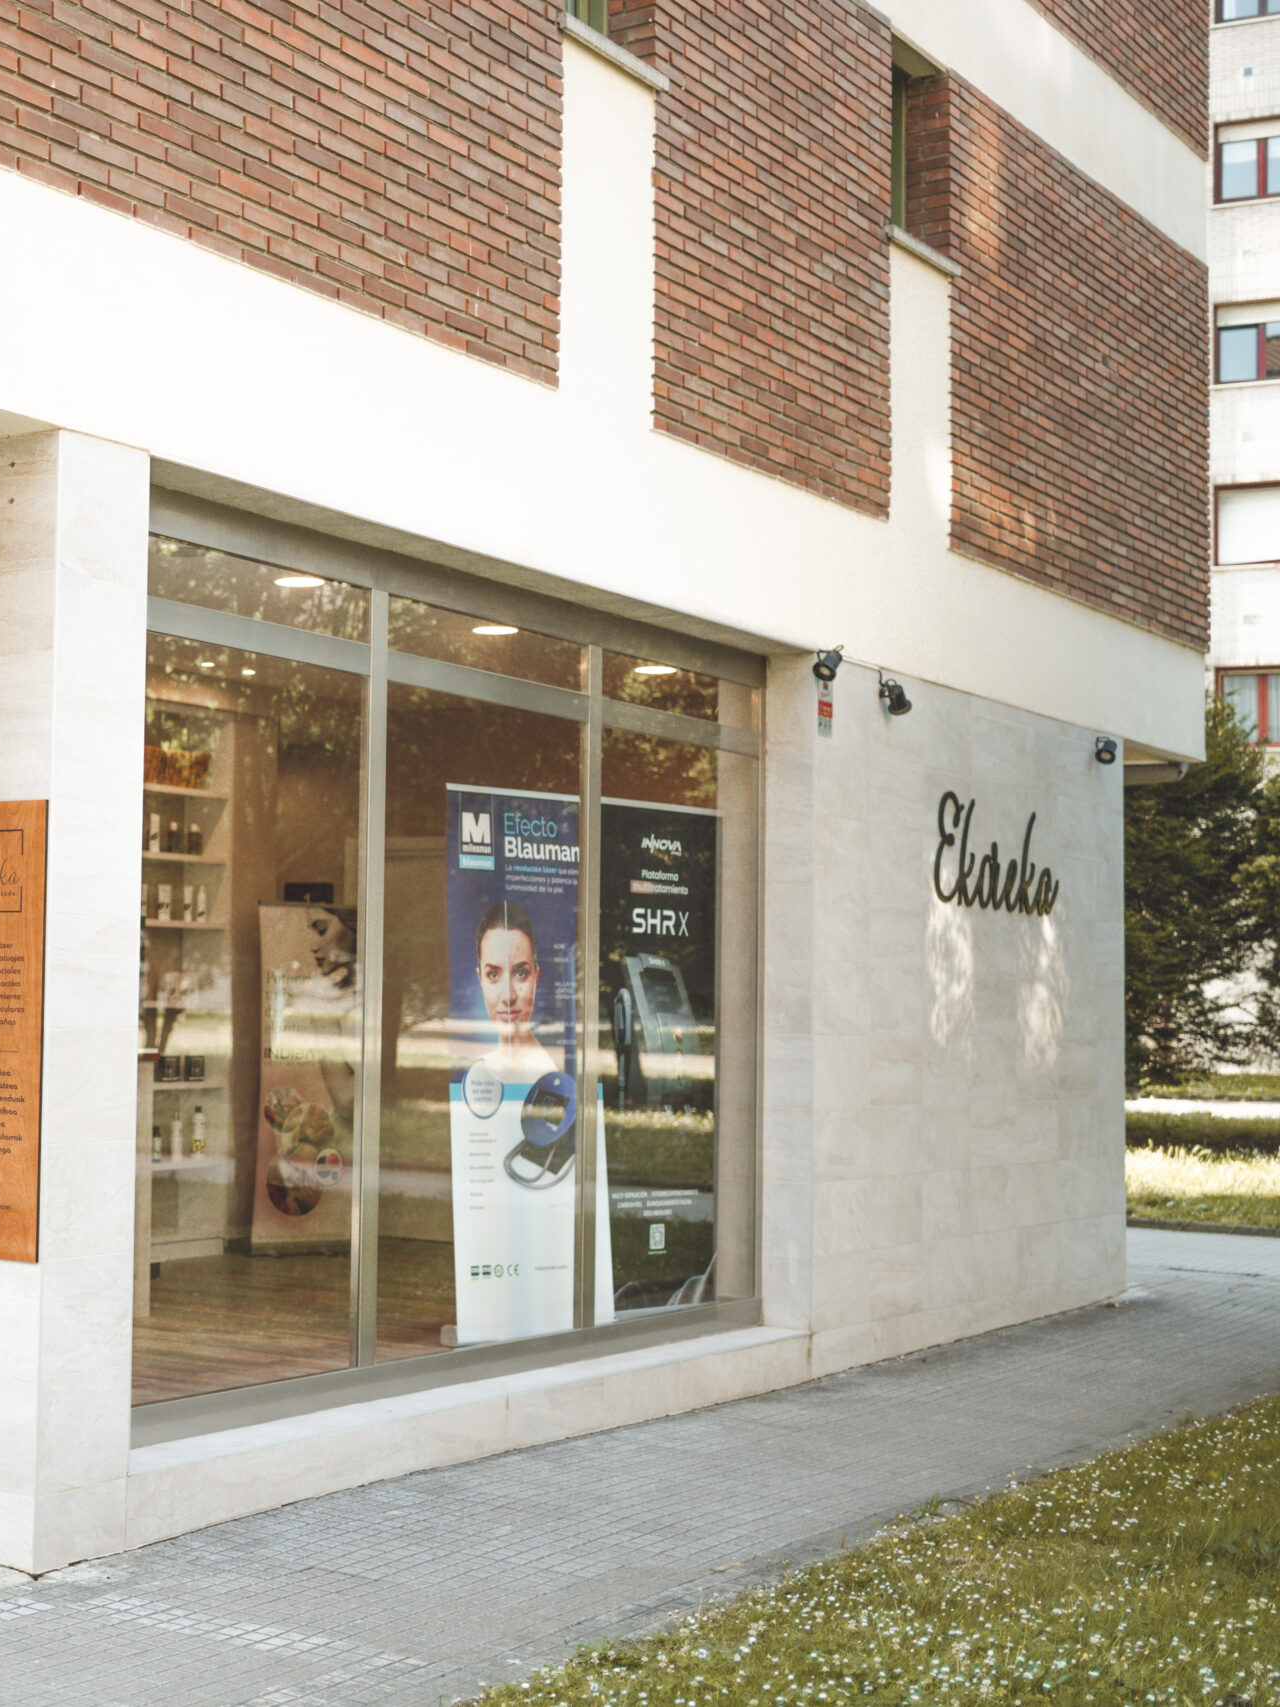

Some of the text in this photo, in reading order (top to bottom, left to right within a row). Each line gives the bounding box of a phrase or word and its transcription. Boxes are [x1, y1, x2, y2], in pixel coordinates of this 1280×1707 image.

[461, 811, 491, 844] M
[504, 812, 557, 838] Efecto
[462, 844, 492, 854] milesman
[504, 835, 580, 863] Blauman
[641, 833, 682, 854] INNOVA
[933, 790, 1059, 917] Ekoreka
[462, 855, 492, 867] blauman
[641, 868, 679, 882] Plataforma
[631, 882, 689, 896] multitratamiento
